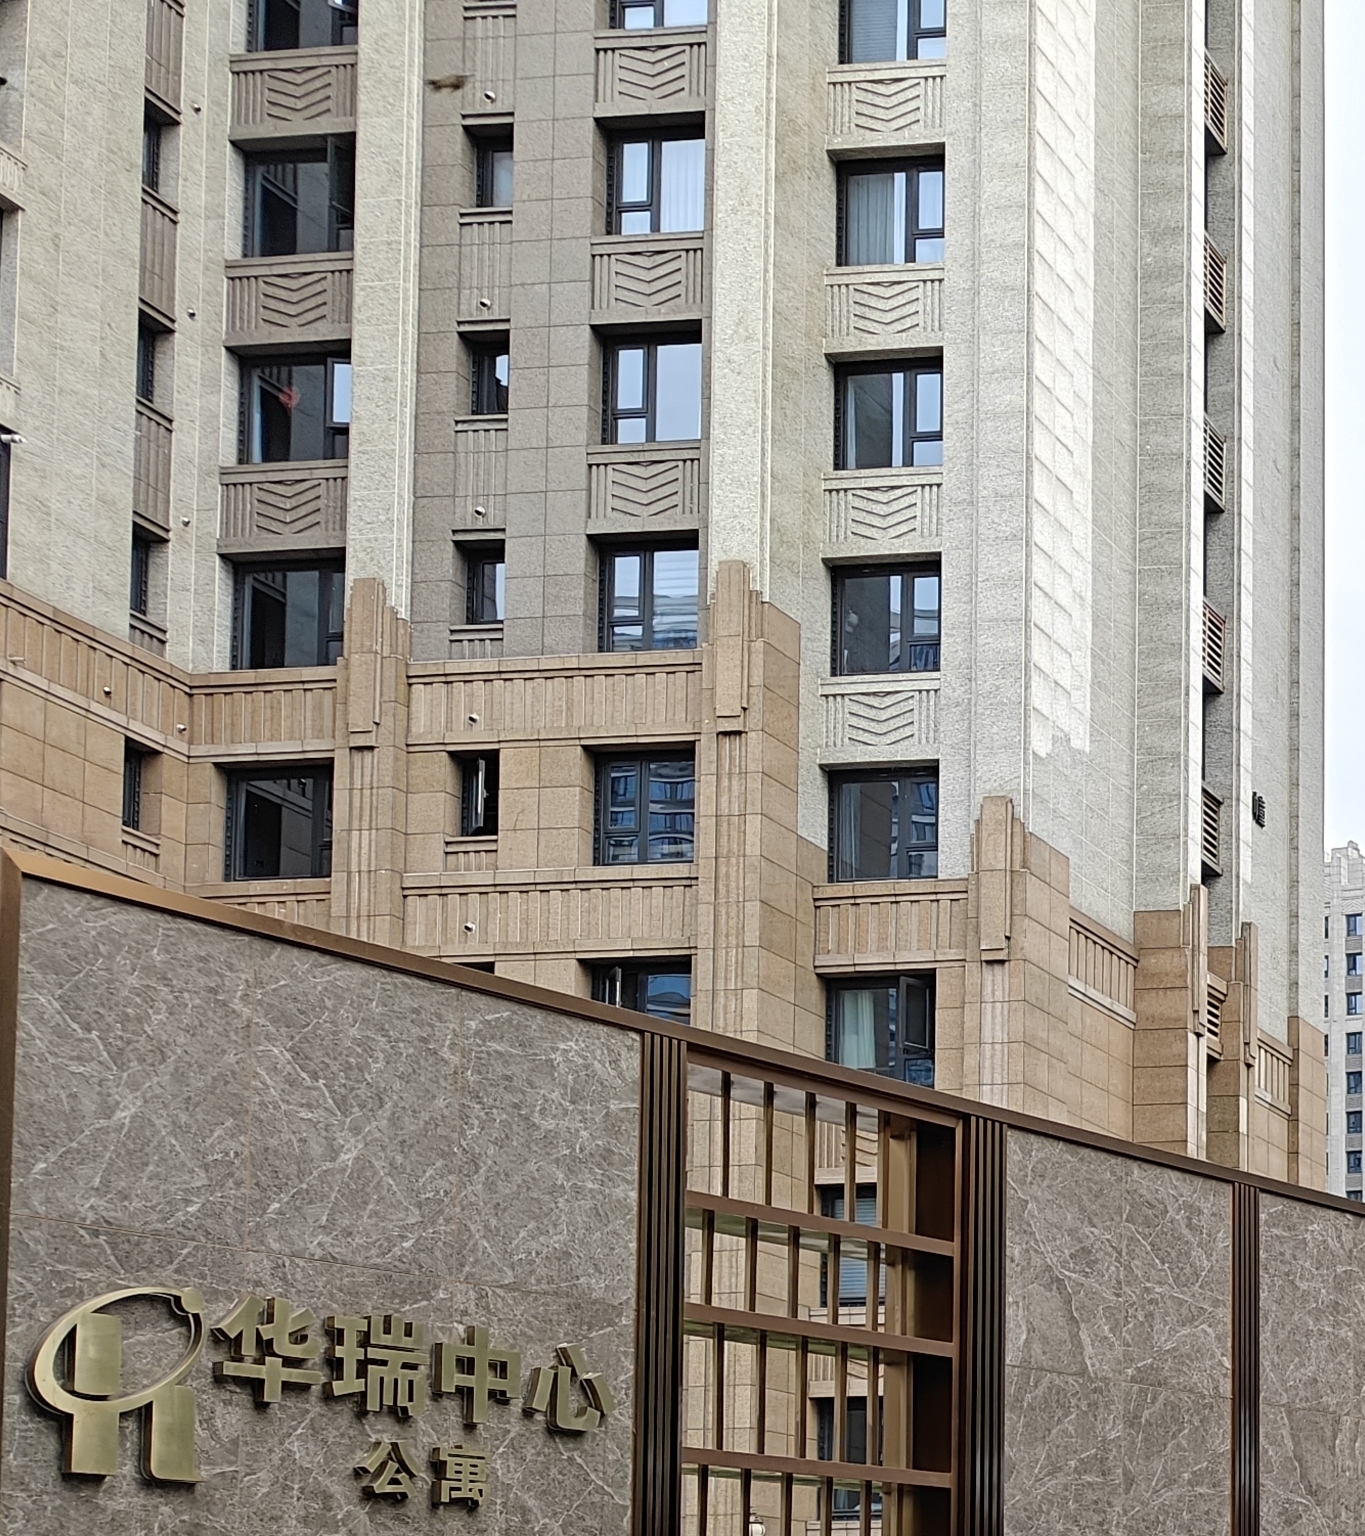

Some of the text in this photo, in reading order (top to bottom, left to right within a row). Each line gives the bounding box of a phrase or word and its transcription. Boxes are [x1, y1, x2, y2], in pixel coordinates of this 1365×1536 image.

[211, 1296, 615, 1432] 华瑞中心
[354, 1440, 490, 1509] 公寓
